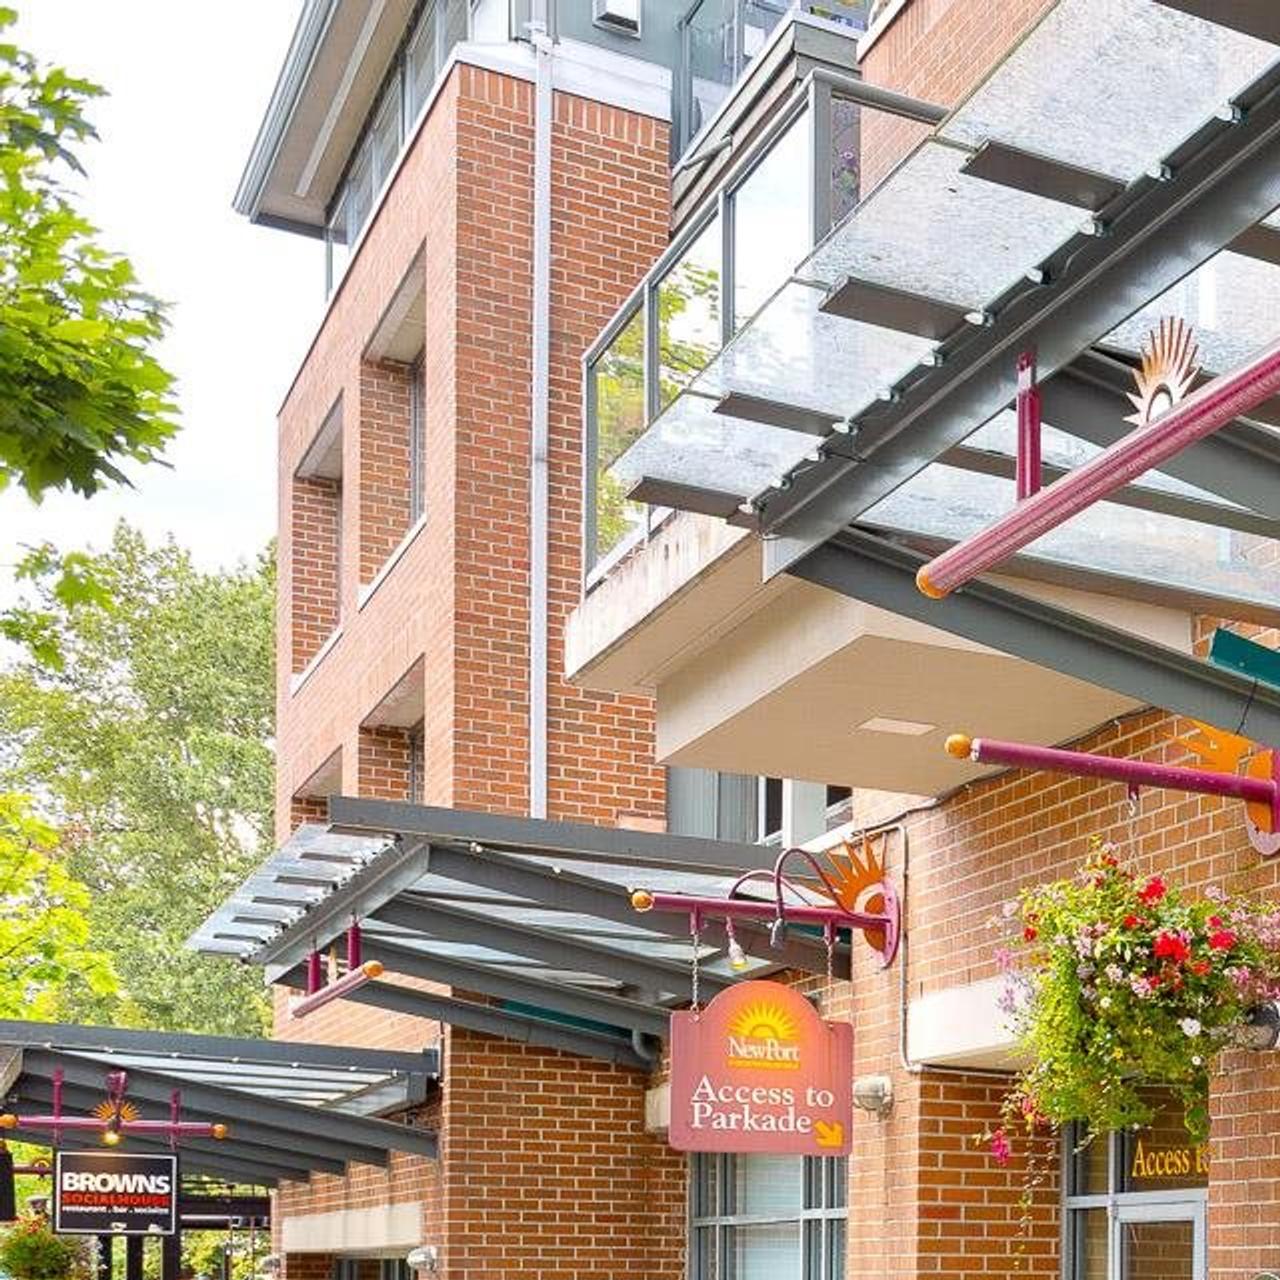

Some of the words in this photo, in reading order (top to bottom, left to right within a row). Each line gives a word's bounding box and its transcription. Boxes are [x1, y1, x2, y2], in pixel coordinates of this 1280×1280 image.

[691, 1074, 794, 1105] Access
[806, 1087, 834, 1107] to
[690, 1102, 811, 1133] Parkade
[1132, 1139, 1190, 1177] Access
[62, 1172, 171, 1194] BROWNS
